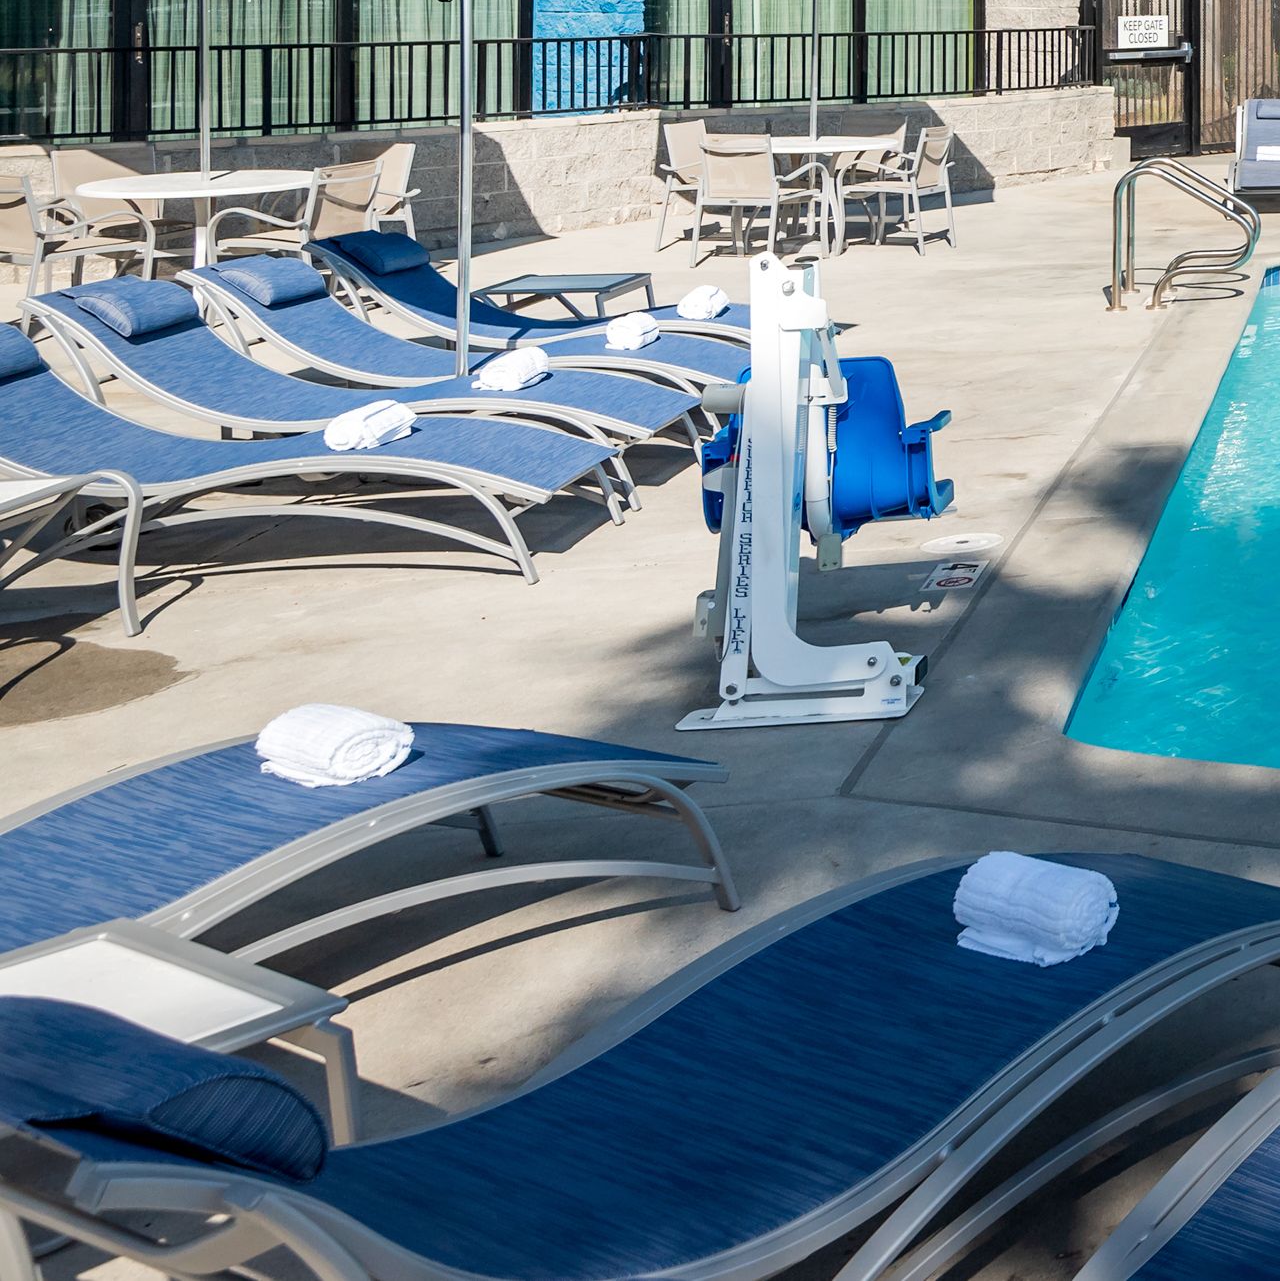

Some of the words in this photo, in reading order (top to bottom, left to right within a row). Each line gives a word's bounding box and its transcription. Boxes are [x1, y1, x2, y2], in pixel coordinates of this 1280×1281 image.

[1123, 20, 1143, 31] KEEP
[1144, 19, 1164, 30] GATE
[1128, 32, 1159, 44] CLOSED
[735, 533, 753, 598] SERIES
[731, 607, 746, 652] LIFT
